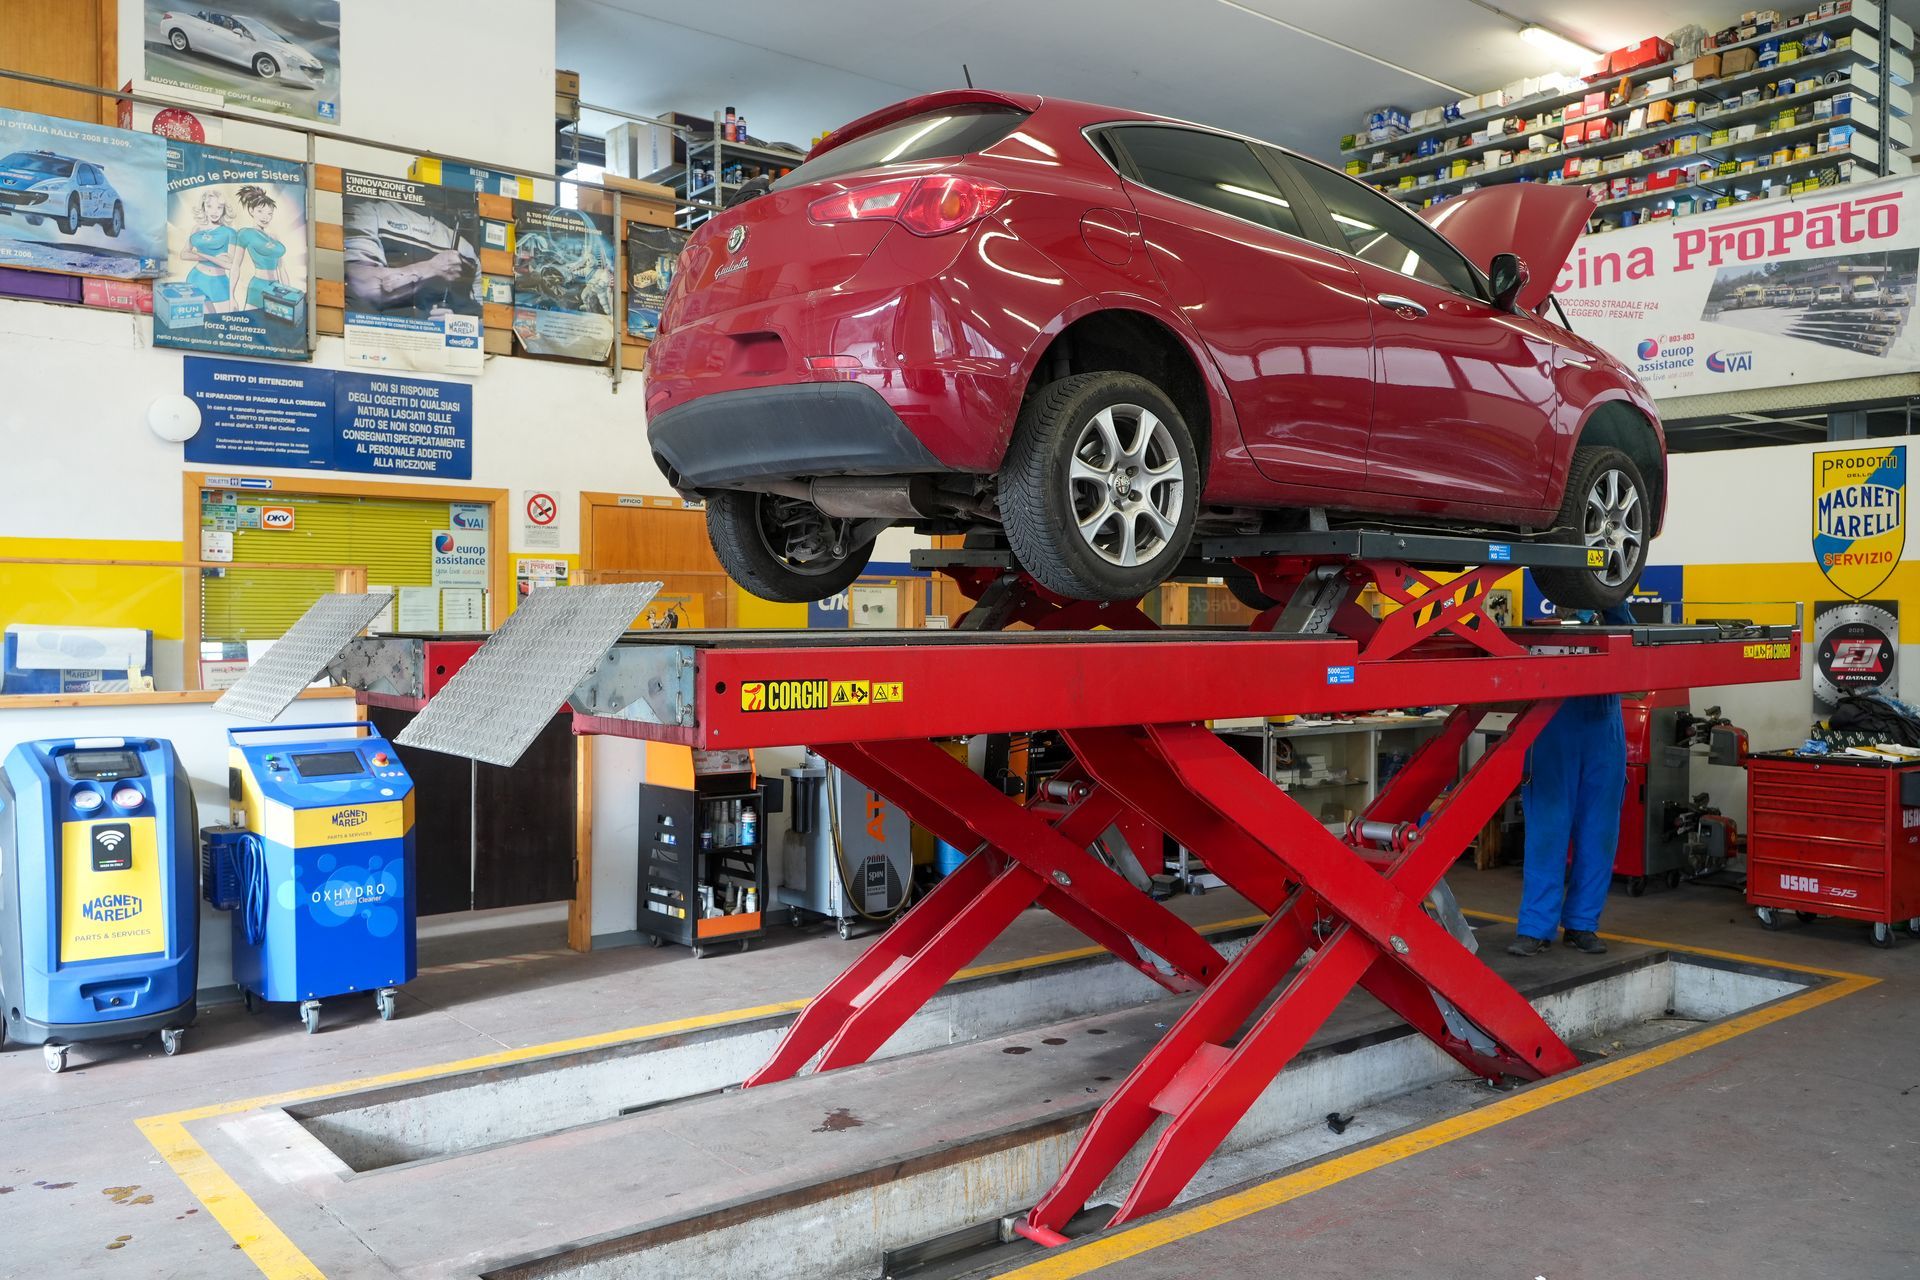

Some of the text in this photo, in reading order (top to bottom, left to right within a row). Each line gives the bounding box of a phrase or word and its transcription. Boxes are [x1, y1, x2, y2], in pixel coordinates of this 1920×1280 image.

[151, 75, 179, 87] NUOVA
[179, 81, 213, 94] PEUGEOT
[8, 121, 49, 135] D'ITALIA
[51, 128, 81, 139] RALLY
[208, 171, 220, 182] le
[223, 169, 258, 180] Power
[261, 170, 300, 183] Sisters
[346, 176, 407, 193] L'INNOVAZIONE
[346, 184, 426, 204] SCORRE NELLE VENE.
[1673, 191, 1904, 273] ProPato
[1558, 297, 1659, 312] SOCCORSO STRADALE H24
[221, 314, 250, 324] spunto
[1566, 308, 1602, 319] LEGGERO
[1609, 310, 1644, 320] PESANTE
[226, 332, 253, 342] durata
[230, 325, 267, 335] sicurezza
[1661, 345, 1694, 361] europ
[1637, 356, 1695, 373] assistance
[1726, 355, 1752, 373] VAI
[214, 373, 304, 389] DIRITTO DI RITENZIONE
[370, 382, 438, 397] NON SI RISPONDE
[205, 392, 244, 401] RIPARAZIONI
[252, 395, 277, 404] PAGANO
[277, 397, 294, 406] ALLA
[295, 399, 326, 407] CONSEGNA
[348, 392, 459, 412] DEGLI OGGETTI DI QUALSIASI
[236, 414, 258, 422] DIRITTO
[264, 417, 296, 425] RITENZIONE
[357, 406, 451, 423] NATURA LASCIATI SULLE
[353, 417, 454, 436] AUTO SE NON SONO STATI
[342, 429, 464, 449] CONSEGNATI SPECIFICATAMENTE
[355, 443, 451, 460] AL PERSONALE ADDETTO
[372, 456, 435, 471] ALLA RICEZIONE
[1823, 456, 1897, 488] PRODOTTI
[1818, 486, 1900, 513] MAGNETI
[266, 514, 289, 522] DKV
[467, 518, 484, 529] VAI
[1818, 508, 1900, 539] MARELLI
[456, 546, 486, 556] europ
[1823, 551, 1893, 566] SERVIZIO
[435, 554, 486, 566] assistance
[768, 681, 828, 711] CORGHI
[312, 883, 385, 903] OXHYDRO
[1780, 873, 1857, 898] USAG 515
[83, 894, 142, 910] MAGNETI
[334, 894, 382, 907] Carbon Cleaner
[83, 906, 142, 922] MARELLI
[75, 935, 103, 943] PARTS
[111, 928, 152, 940] SERVICES
